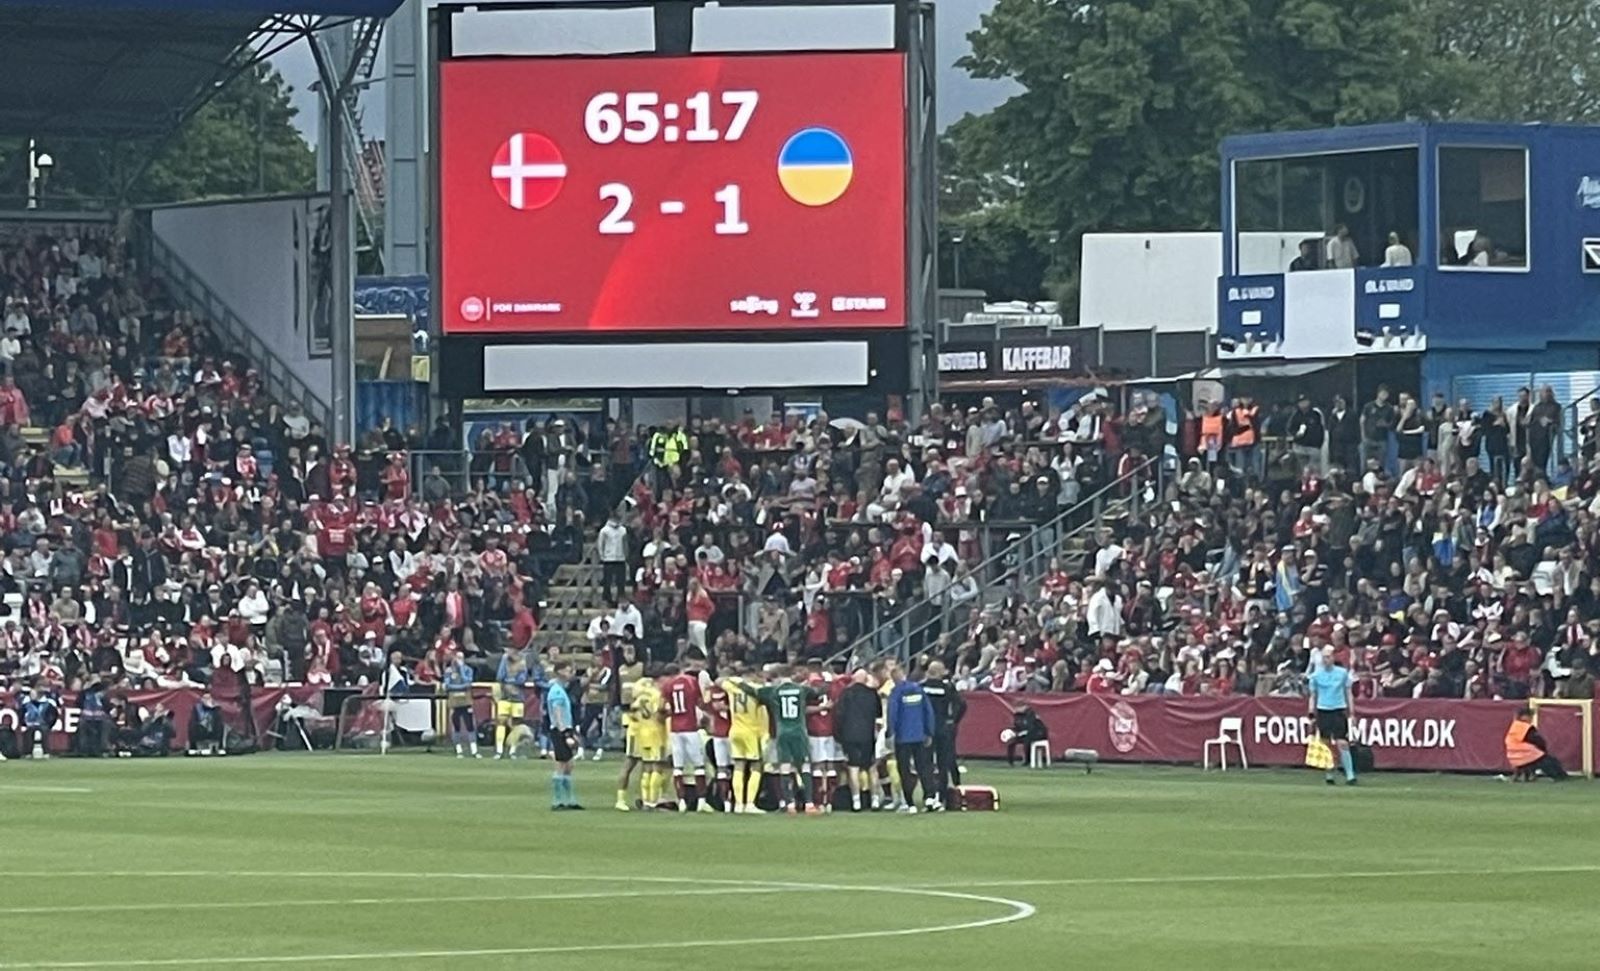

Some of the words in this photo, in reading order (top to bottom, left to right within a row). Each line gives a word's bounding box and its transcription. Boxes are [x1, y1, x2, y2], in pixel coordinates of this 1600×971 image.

[584, 90, 759, 144] 65:17
[599, 183, 635, 234] 2
[715, 184, 749, 234] 1
[1002, 345, 1071, 371] KAFFEBAR
[672, 691, 687, 714] 11
[780, 696, 799, 719] 16
[1254, 715, 1456, 748] FORDMARK.DK
